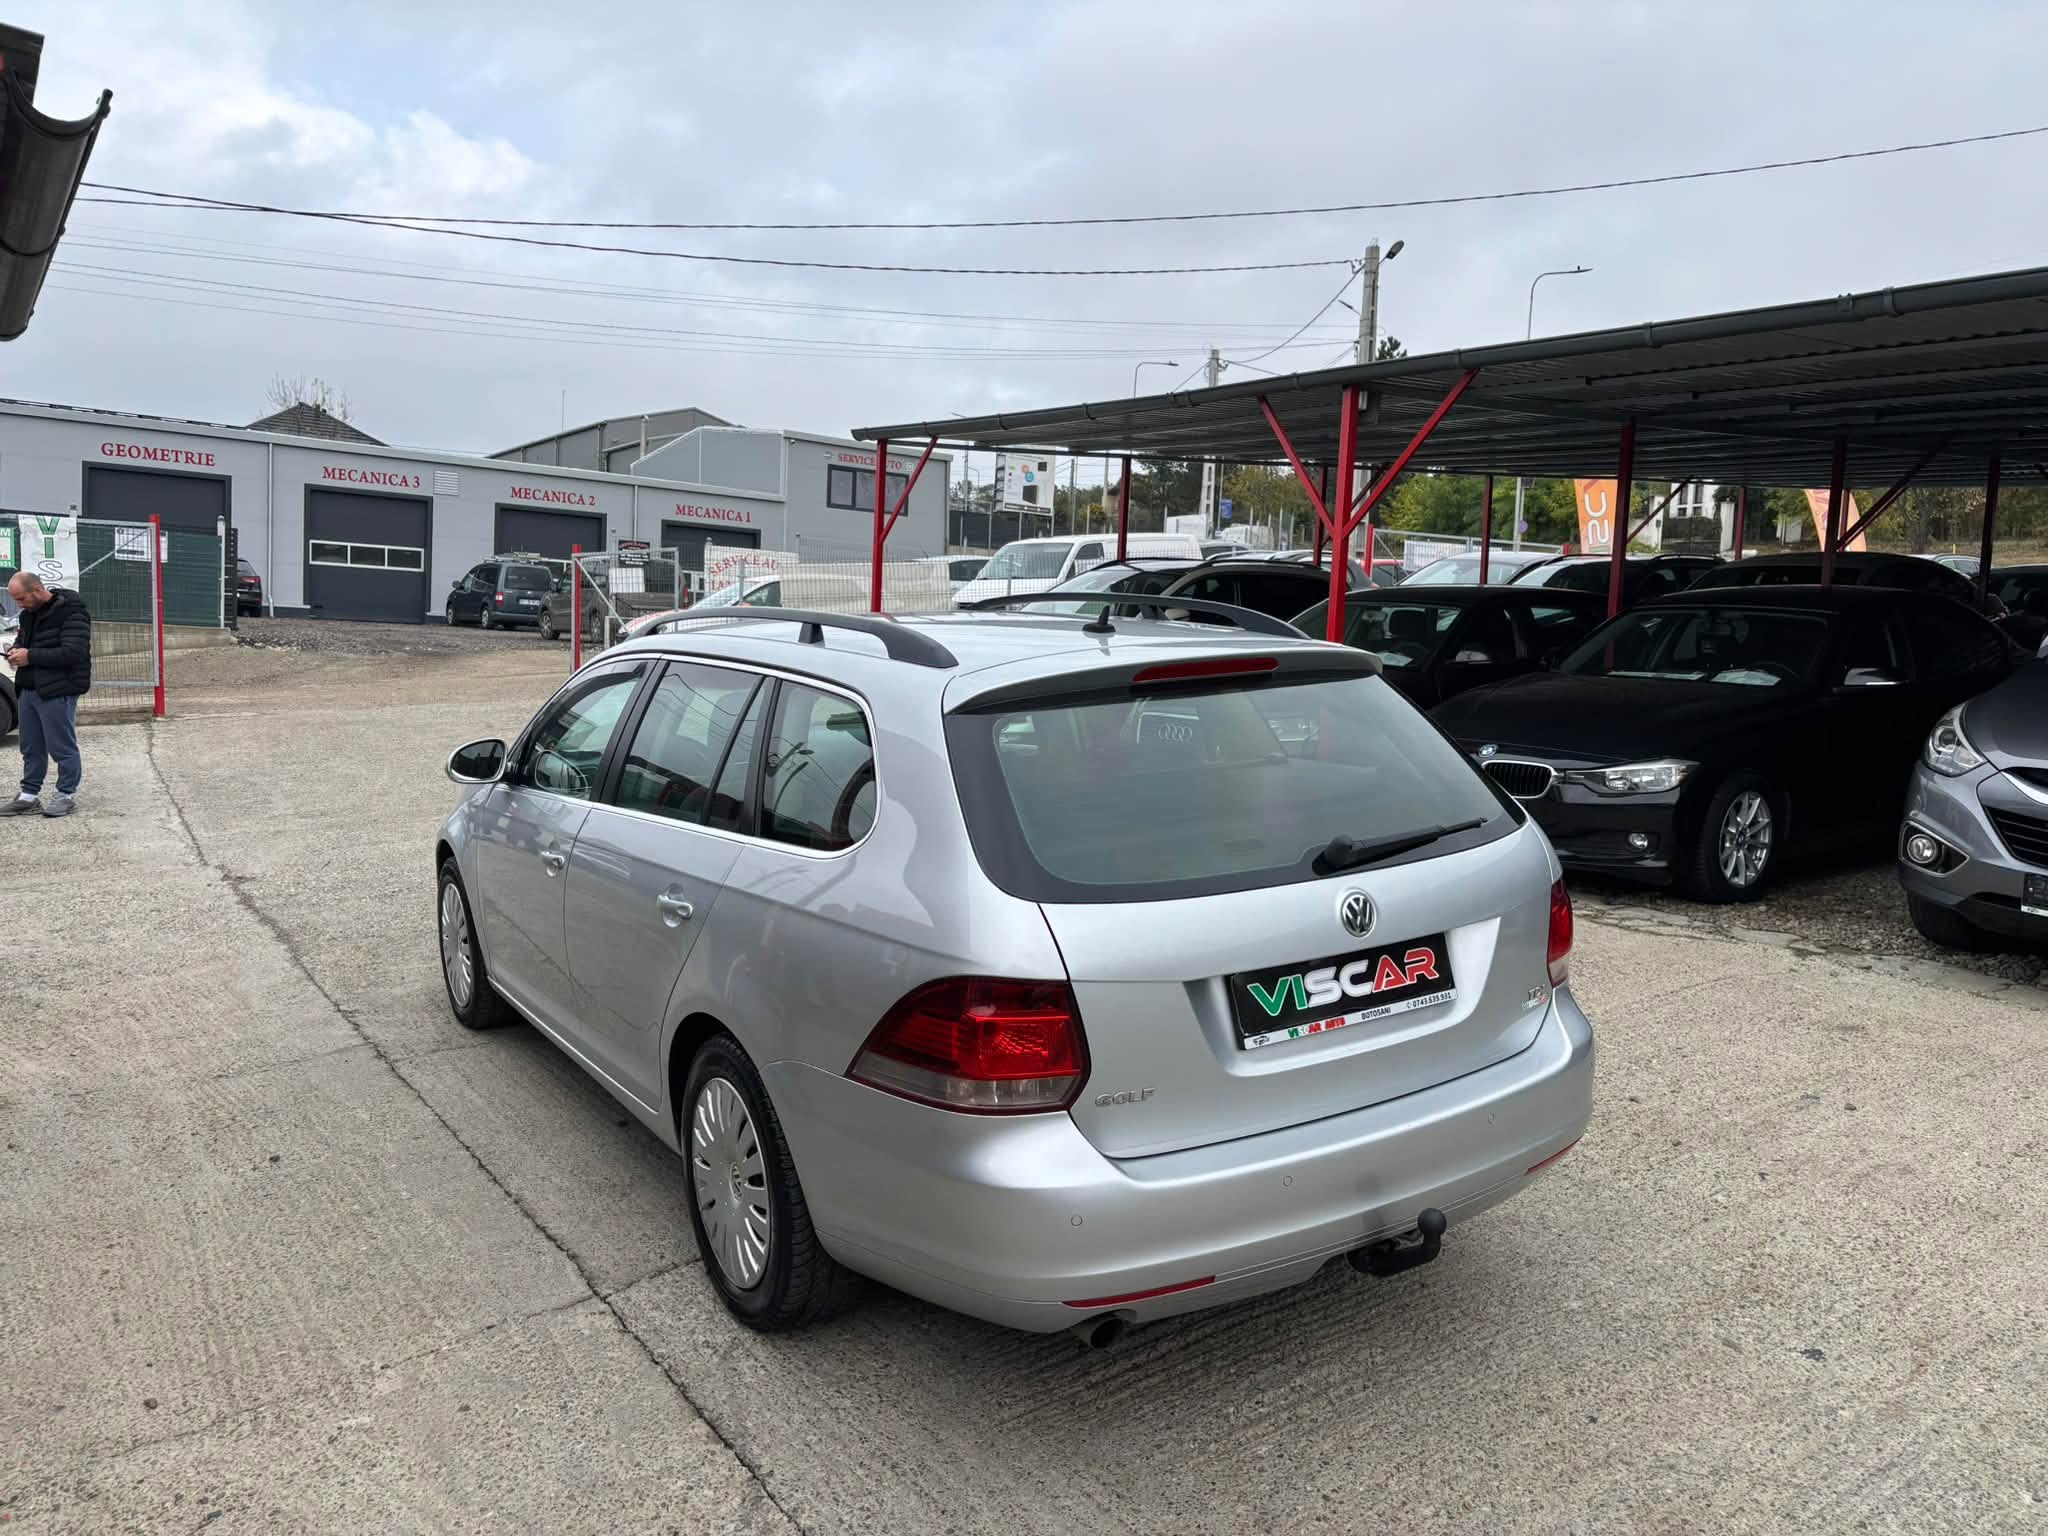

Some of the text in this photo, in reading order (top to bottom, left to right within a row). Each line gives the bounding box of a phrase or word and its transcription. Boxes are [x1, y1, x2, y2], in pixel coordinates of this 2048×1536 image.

[101, 442, 215, 467] GEOMETRIE
[322, 466, 421, 489] MECANICA 3
[511, 486, 597, 506] MECANICA 2
[675, 504, 752, 523] MECANICA 1
[710, 553, 761, 576] SERVCE
[1247, 946, 1439, 1017] VISCAR
[1095, 1087, 1156, 1106] GOLF
